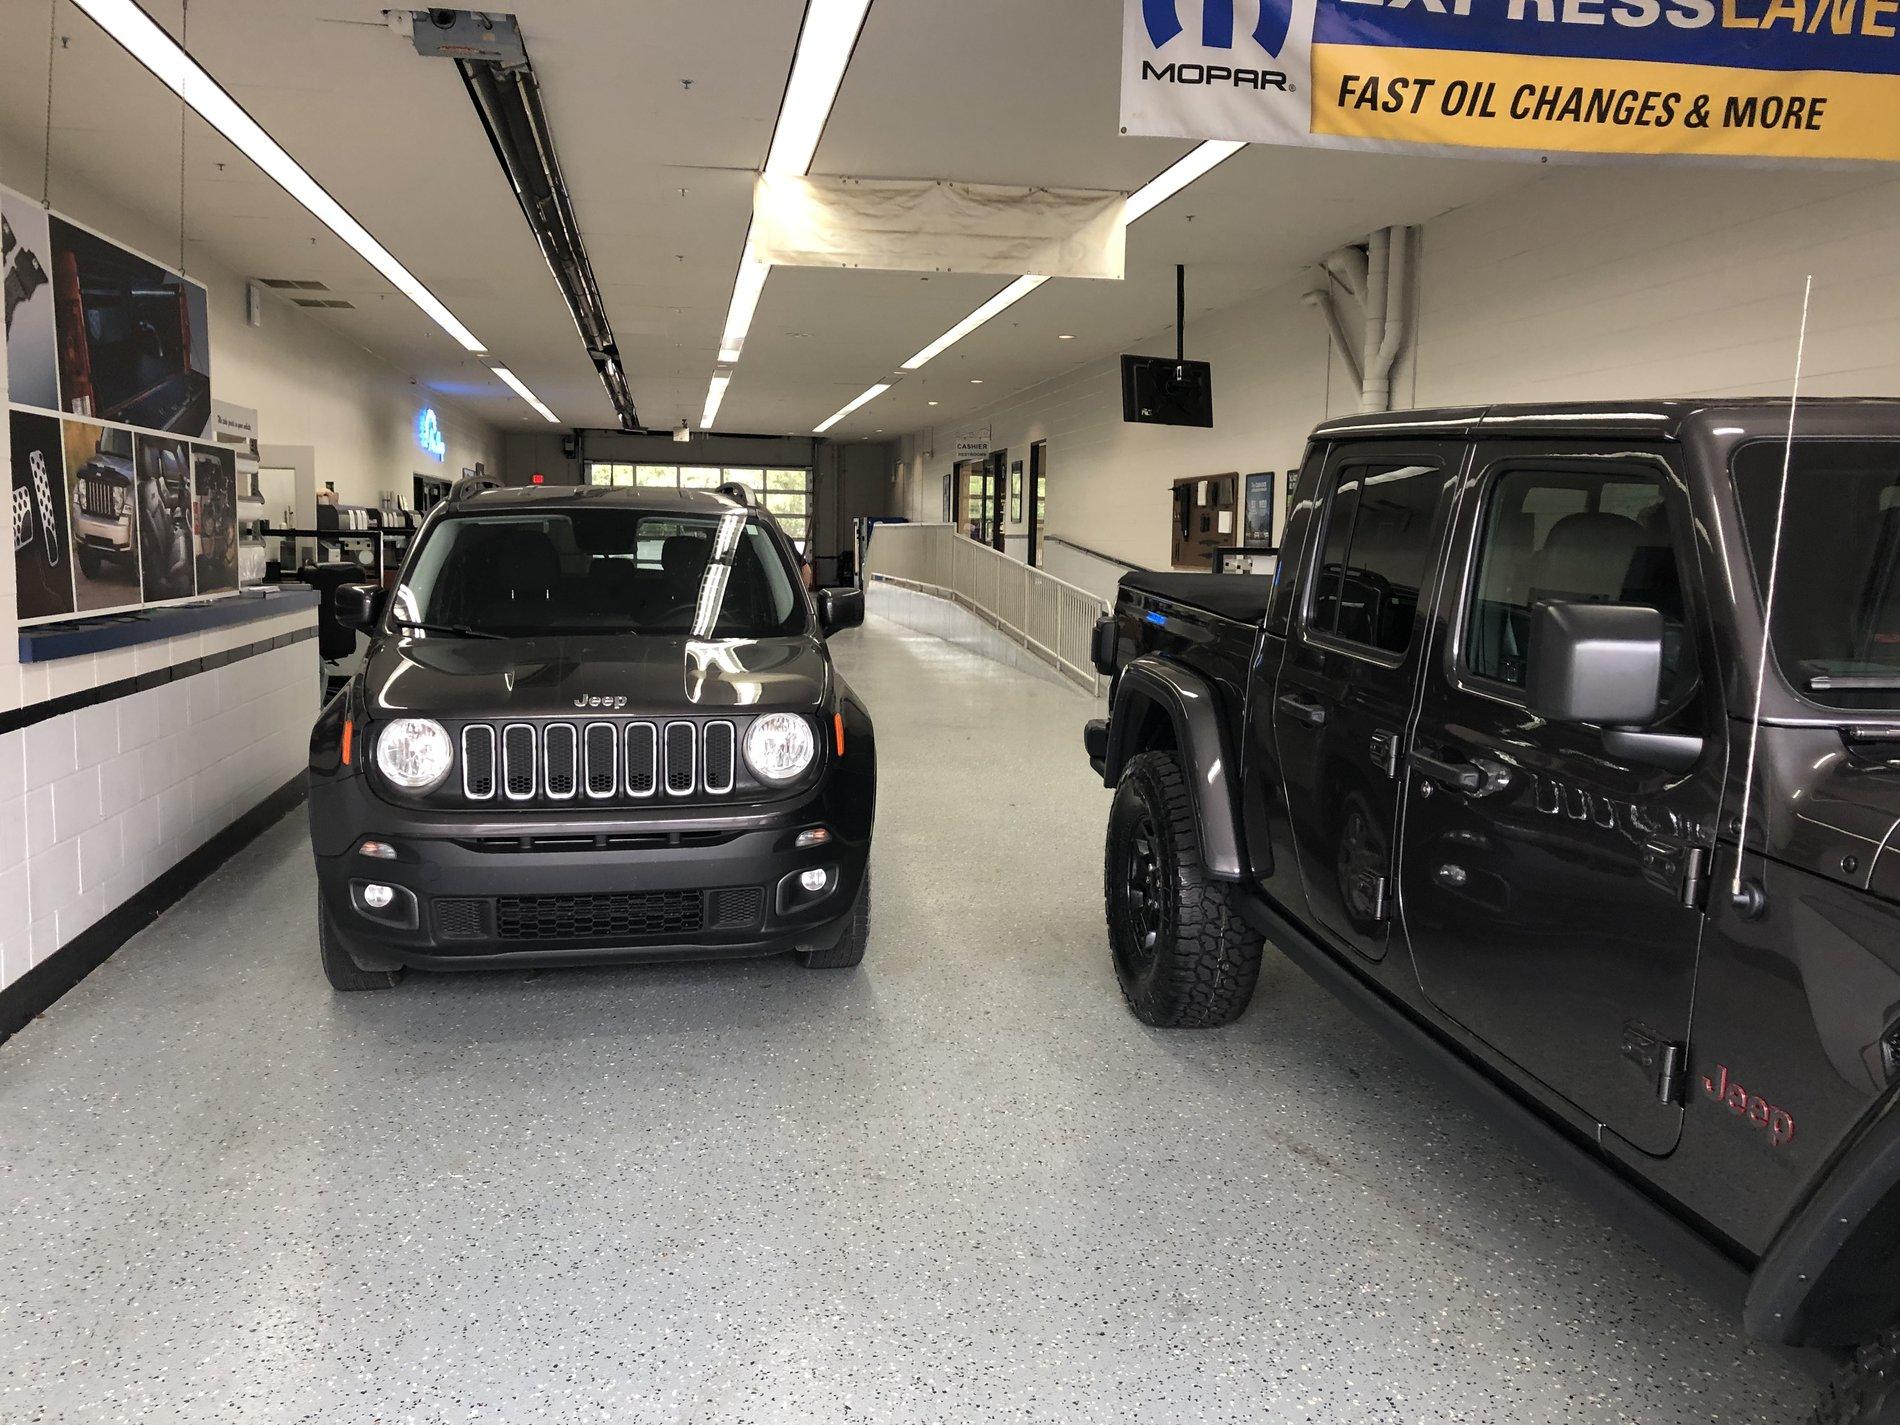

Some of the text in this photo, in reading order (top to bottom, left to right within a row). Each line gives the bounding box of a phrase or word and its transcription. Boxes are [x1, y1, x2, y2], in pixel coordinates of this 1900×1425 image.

[1337, 74, 1828, 131] FAST OIL CHANGES & MORE
[573, 693, 628, 710] Jeep
[1702, 1063, 1796, 1147] Jeep
